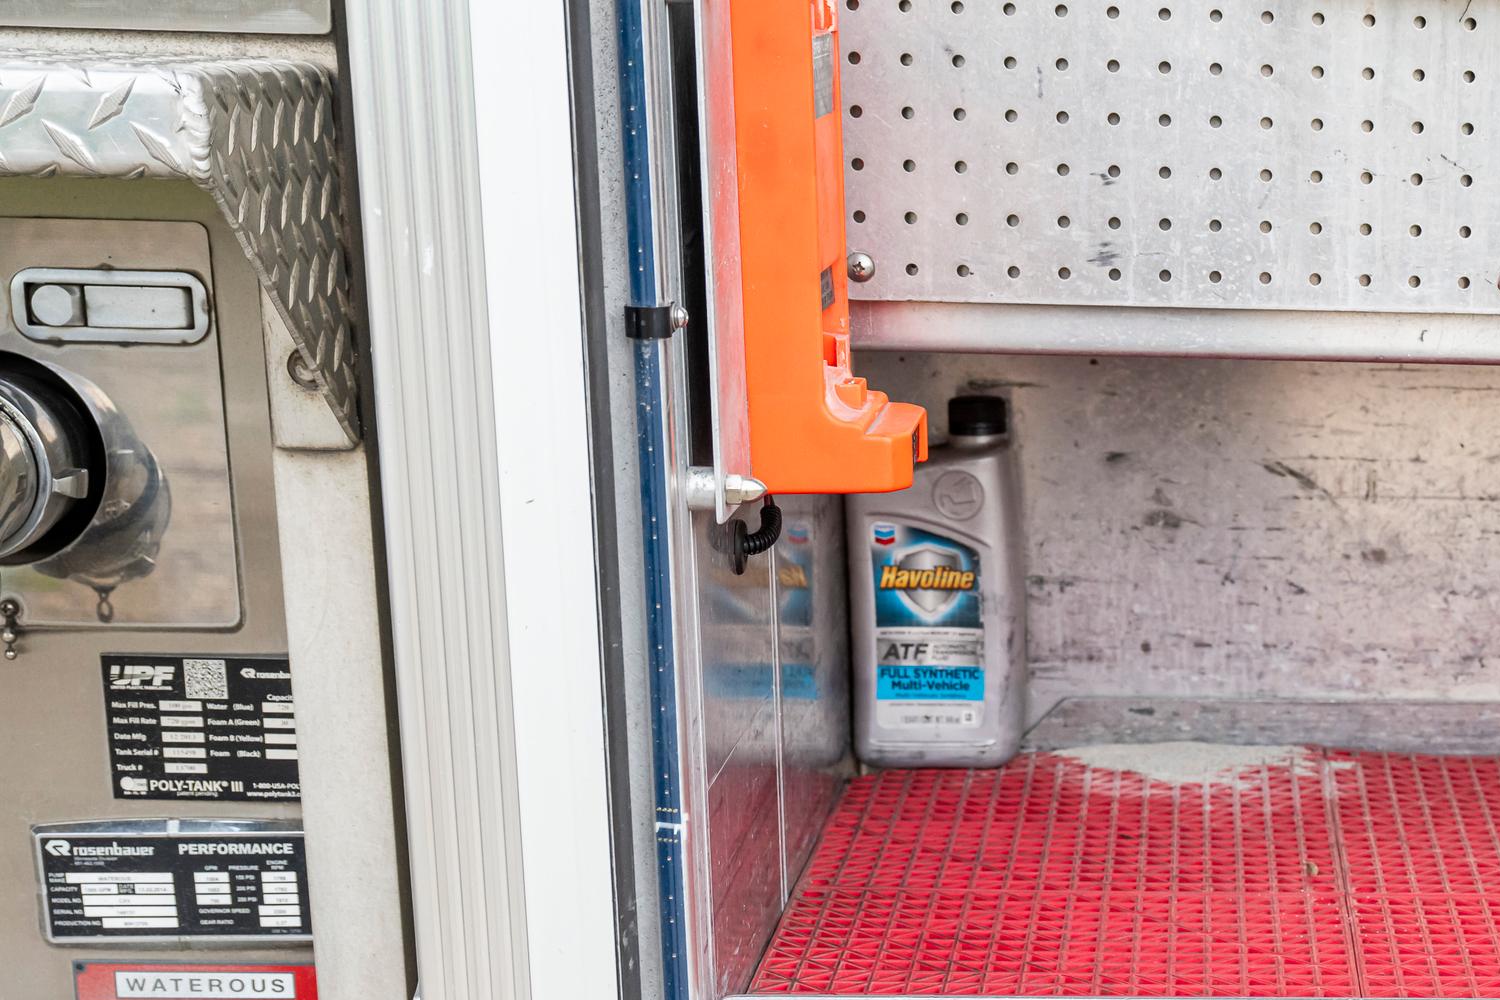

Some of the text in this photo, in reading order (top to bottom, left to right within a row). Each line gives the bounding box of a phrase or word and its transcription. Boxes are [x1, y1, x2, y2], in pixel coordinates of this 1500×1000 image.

[880, 565, 977, 590] Havoline
[883, 643, 928, 660] ATF
[109, 665, 175, 686] UPF
[880, 668, 979, 680] FULL SYNTHETIC
[891, 680, 970, 691] Multi-Vehicle
[207, 718, 227, 726] Foam
[235, 718, 260, 727] (Green)
[114, 732, 131, 740] Date
[209, 734, 229, 742] Foam
[210, 749, 230, 757] Foam
[231, 780, 244, 792] III
[73, 841, 155, 856] rosenbauer
[178, 843, 294, 855] PERFORMANCE
[126, 978, 285, 993] WATEROUS
